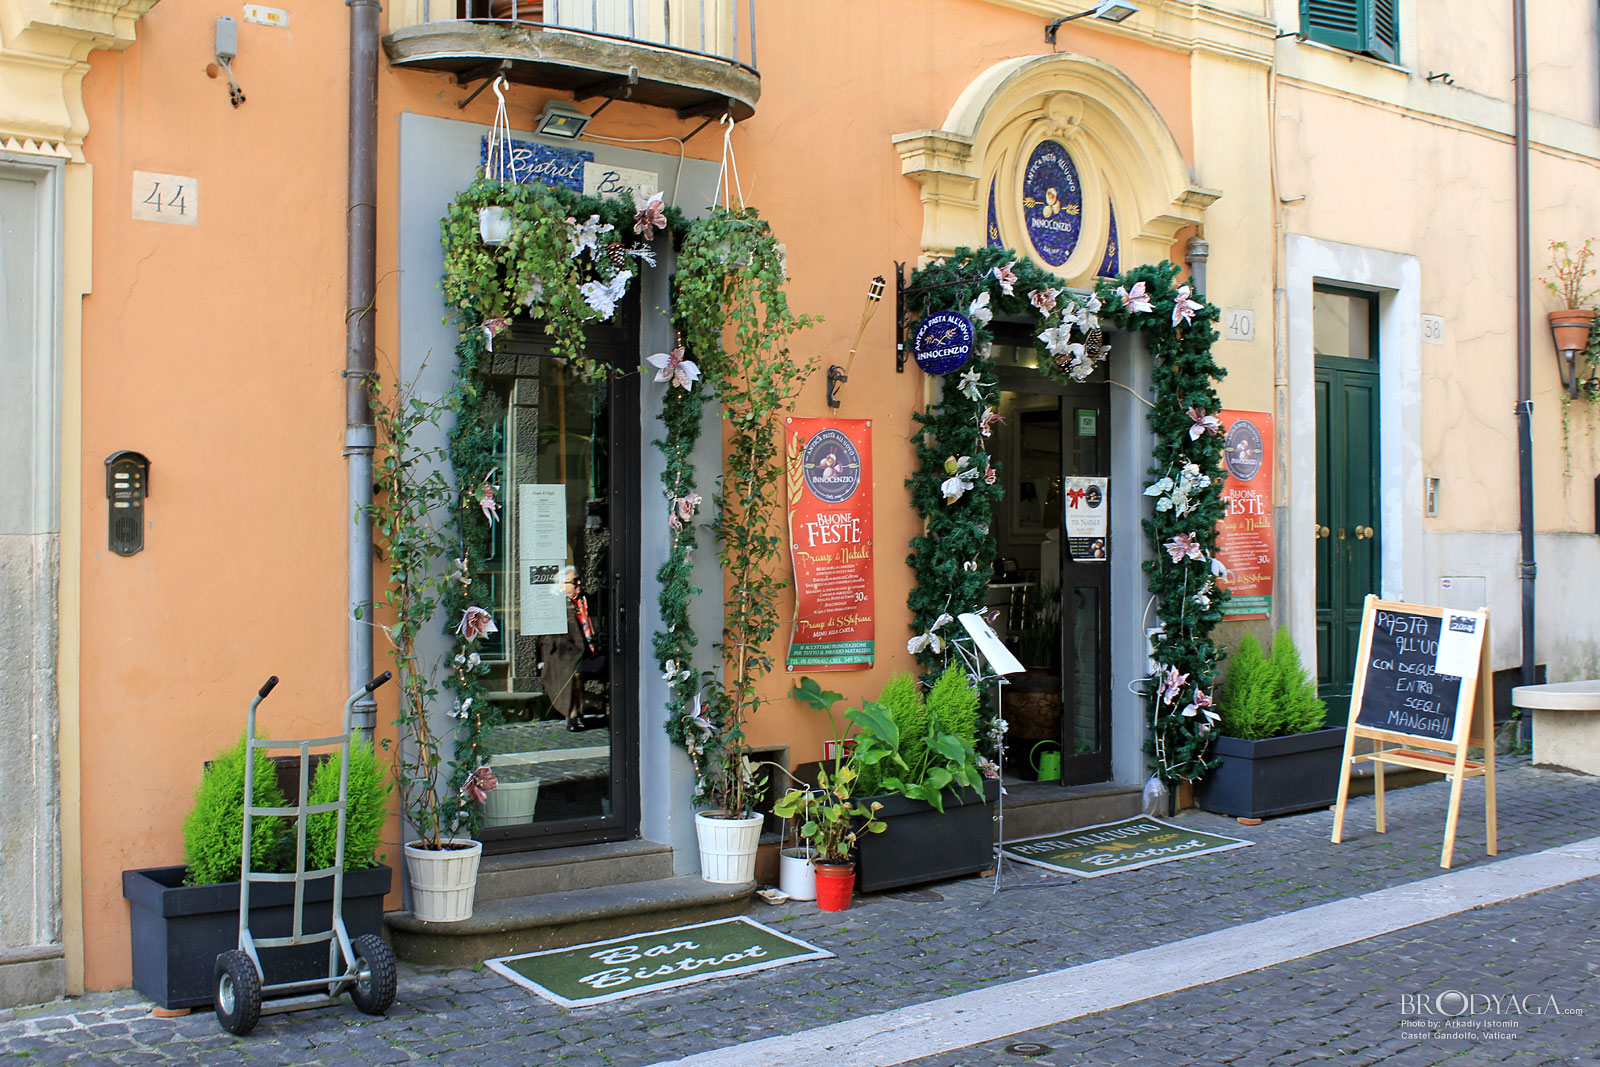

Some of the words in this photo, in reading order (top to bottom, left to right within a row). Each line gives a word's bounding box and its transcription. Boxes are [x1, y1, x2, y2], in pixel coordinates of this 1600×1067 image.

[506, 148, 580, 184] Bistrot
[1026, 158, 1042, 184] ANTICA
[1042, 152, 1056, 164] PASTA
[1057, 158, 1076, 192] ALL'UOVO
[142, 182, 187, 216] 44
[1032, 217, 1072, 232] INNOCENZIO
[914, 324, 928, 351] ANTICA
[928, 315, 946, 327] PASTA
[948, 315, 969, 341] ALL'UOVO
[1230, 314, 1250, 336] 40
[1424, 319, 1440, 339] 38
[917, 345, 969, 360] INNOCENZIO
[807, 436, 822, 456] ANTICA
[822, 432, 835, 440] PASTA
[836, 434, 855, 456] ALL'UOVO
[1230, 489, 1256, 499] BUONE
[816, 512, 852, 526] BUONE
[1081, 518, 1100, 526] NATALE
[805, 518, 861, 547] FESTE
[841, 544, 870, 563] Natale
[827, 618, 835, 627] di
[1377, 612, 1429, 636] PASTA
[1450, 622, 1474, 632] 2014
[1372, 658, 1394, 670] CON
[1396, 678, 1433, 694] ENTRA
[1403, 698, 1444, 715] SCEGLI
[1011, 839, 1073, 855] PASTA
[1072, 822, 1161, 849] ALL'UOVO
[1080, 838, 1207, 866] Bistrot
[590, 939, 700, 966] Bar
[578, 944, 768, 990] Bistrot
